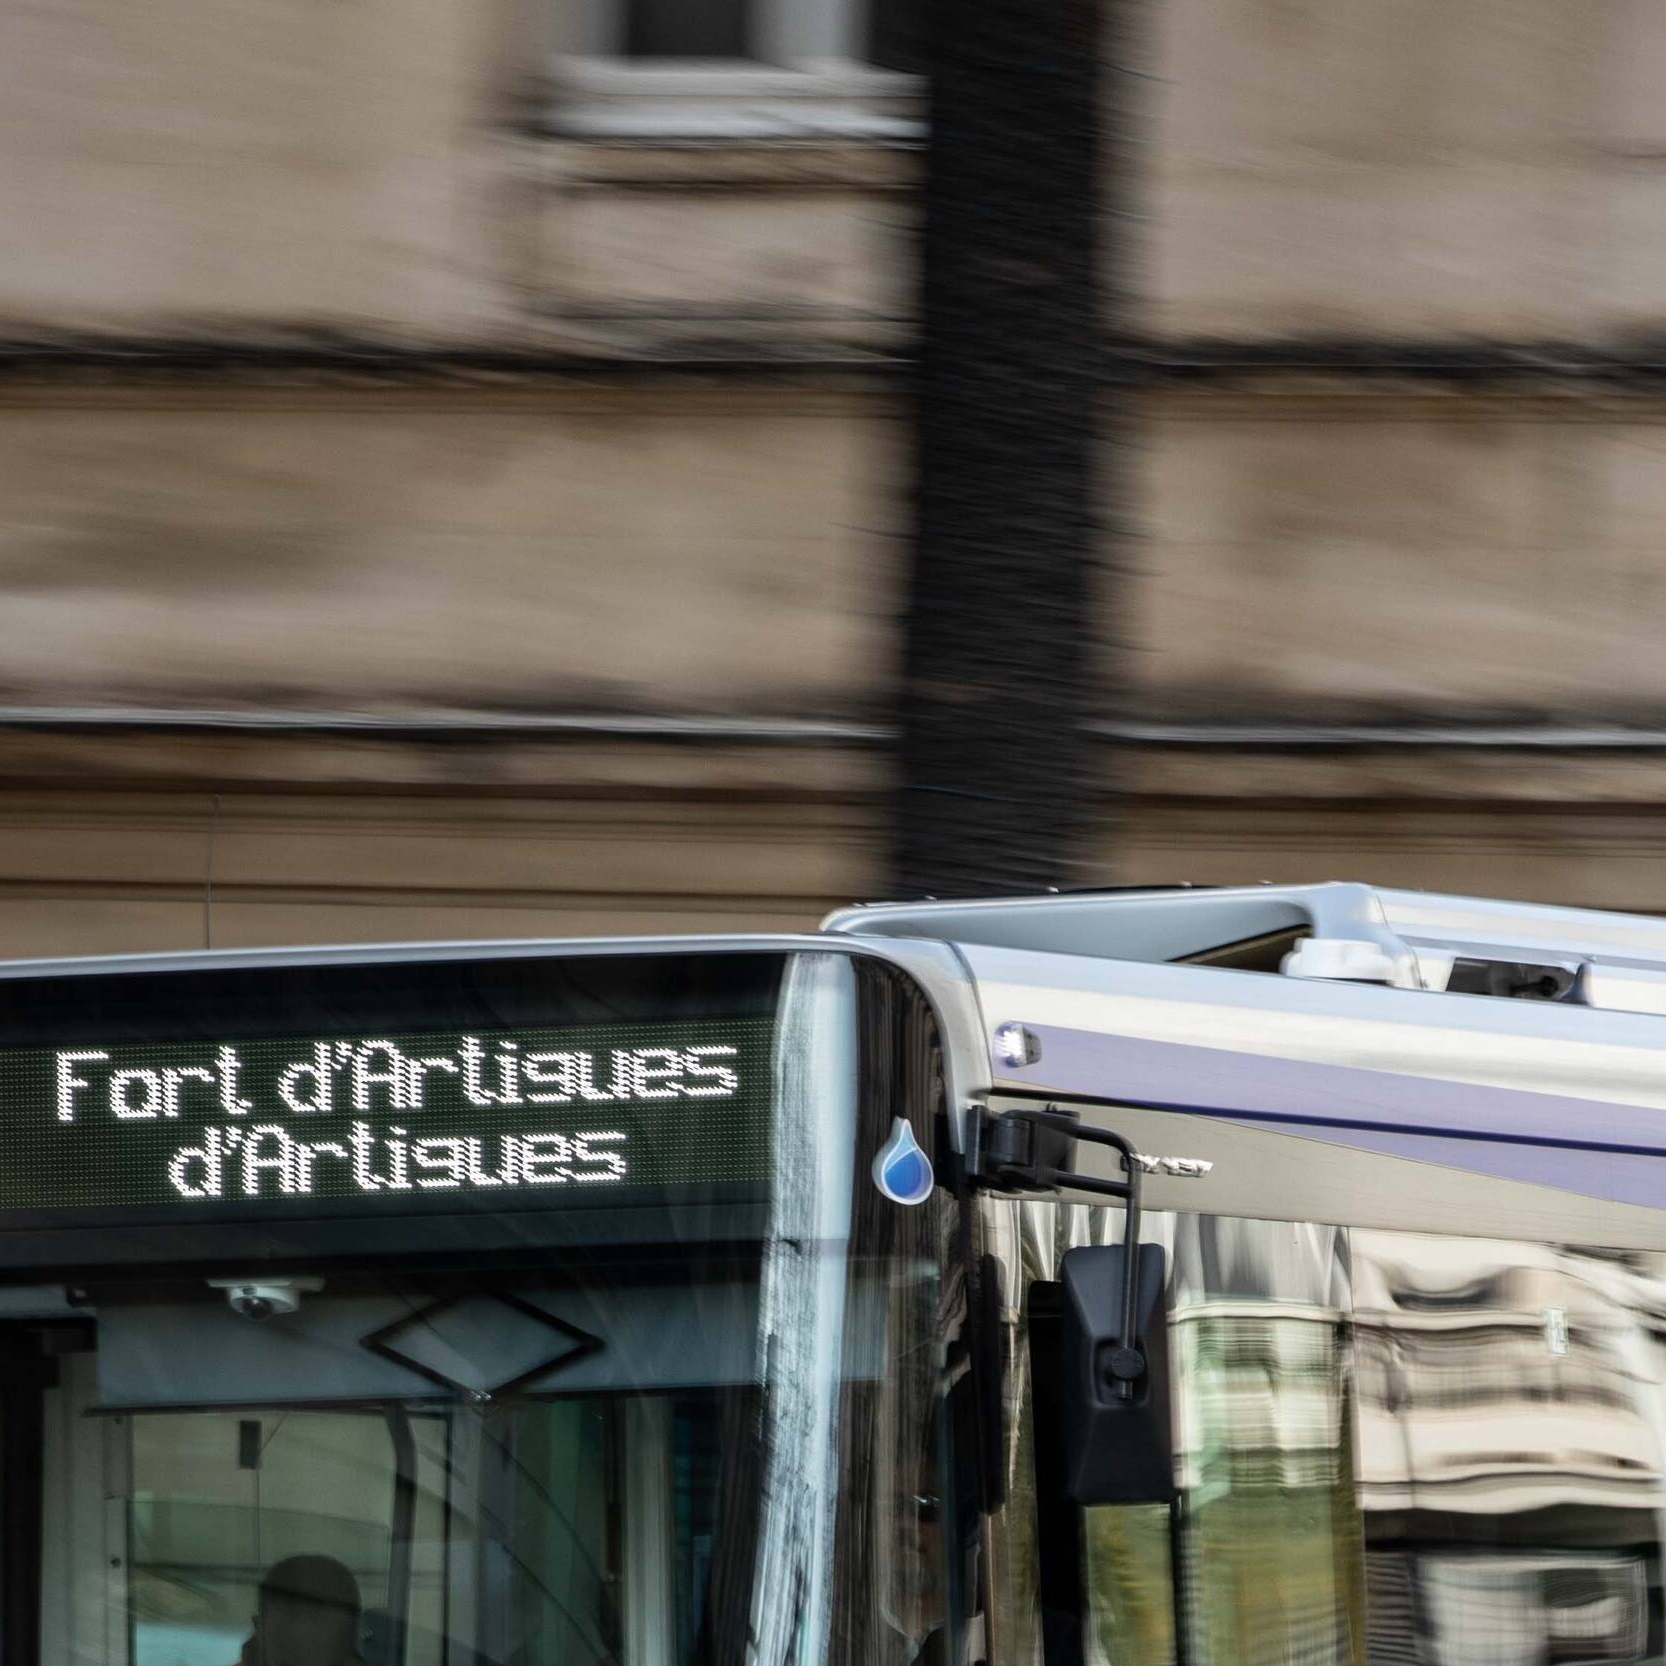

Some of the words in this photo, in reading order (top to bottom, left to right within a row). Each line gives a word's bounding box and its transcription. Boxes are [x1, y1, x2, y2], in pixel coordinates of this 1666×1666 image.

[55, 1045, 252, 1121] Fort
[279, 1036, 738, 1112] d'Artigues
[167, 1120, 627, 1198] d'Artigues
